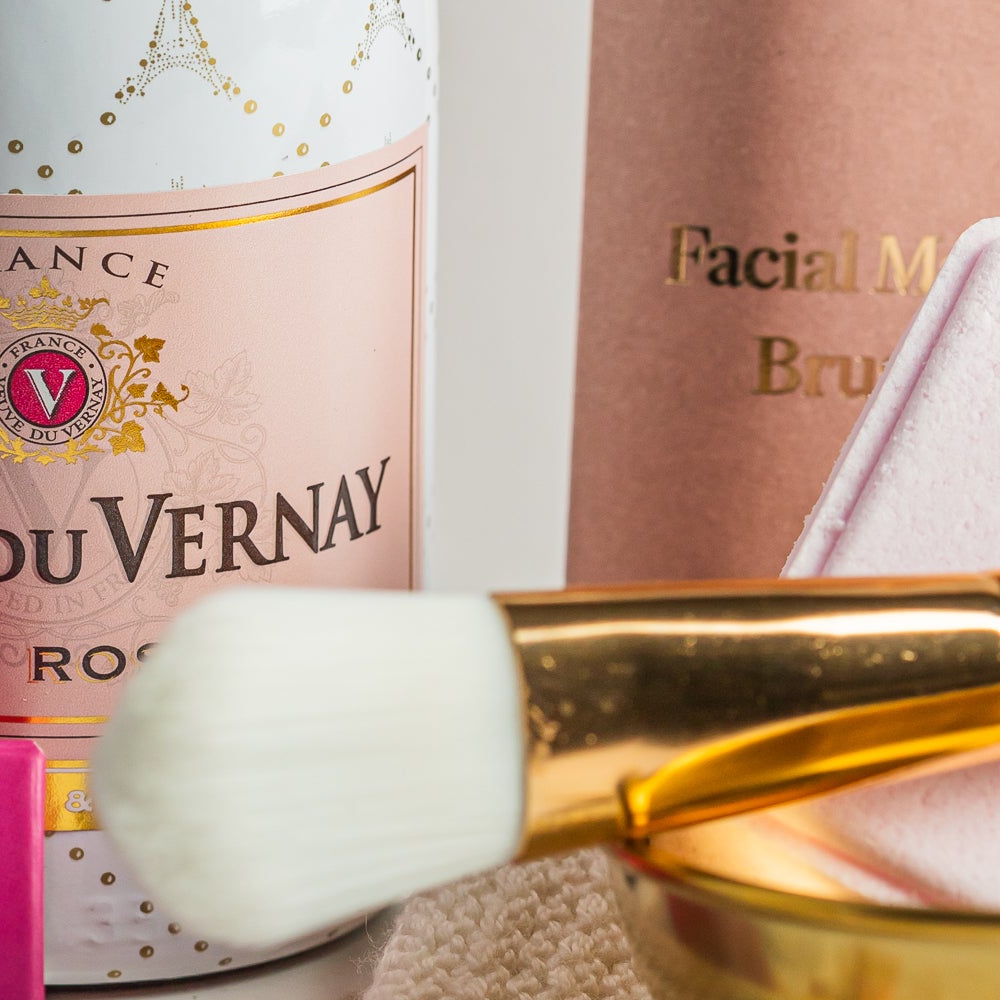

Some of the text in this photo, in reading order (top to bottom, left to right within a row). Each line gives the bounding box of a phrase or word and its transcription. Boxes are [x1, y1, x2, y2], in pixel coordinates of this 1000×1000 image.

[665, 224, 947, 296] Facial M
[10, 336, 87, 359] FRANCE
[751, 335, 891, 399] Bru
[23, 368, 78, 420] V
[29, 427, 58, 442] DU
[60, 377, 104, 437] VERNAY
[90, 456, 391, 584] VERNAY
[28, 642, 156, 684] RO
